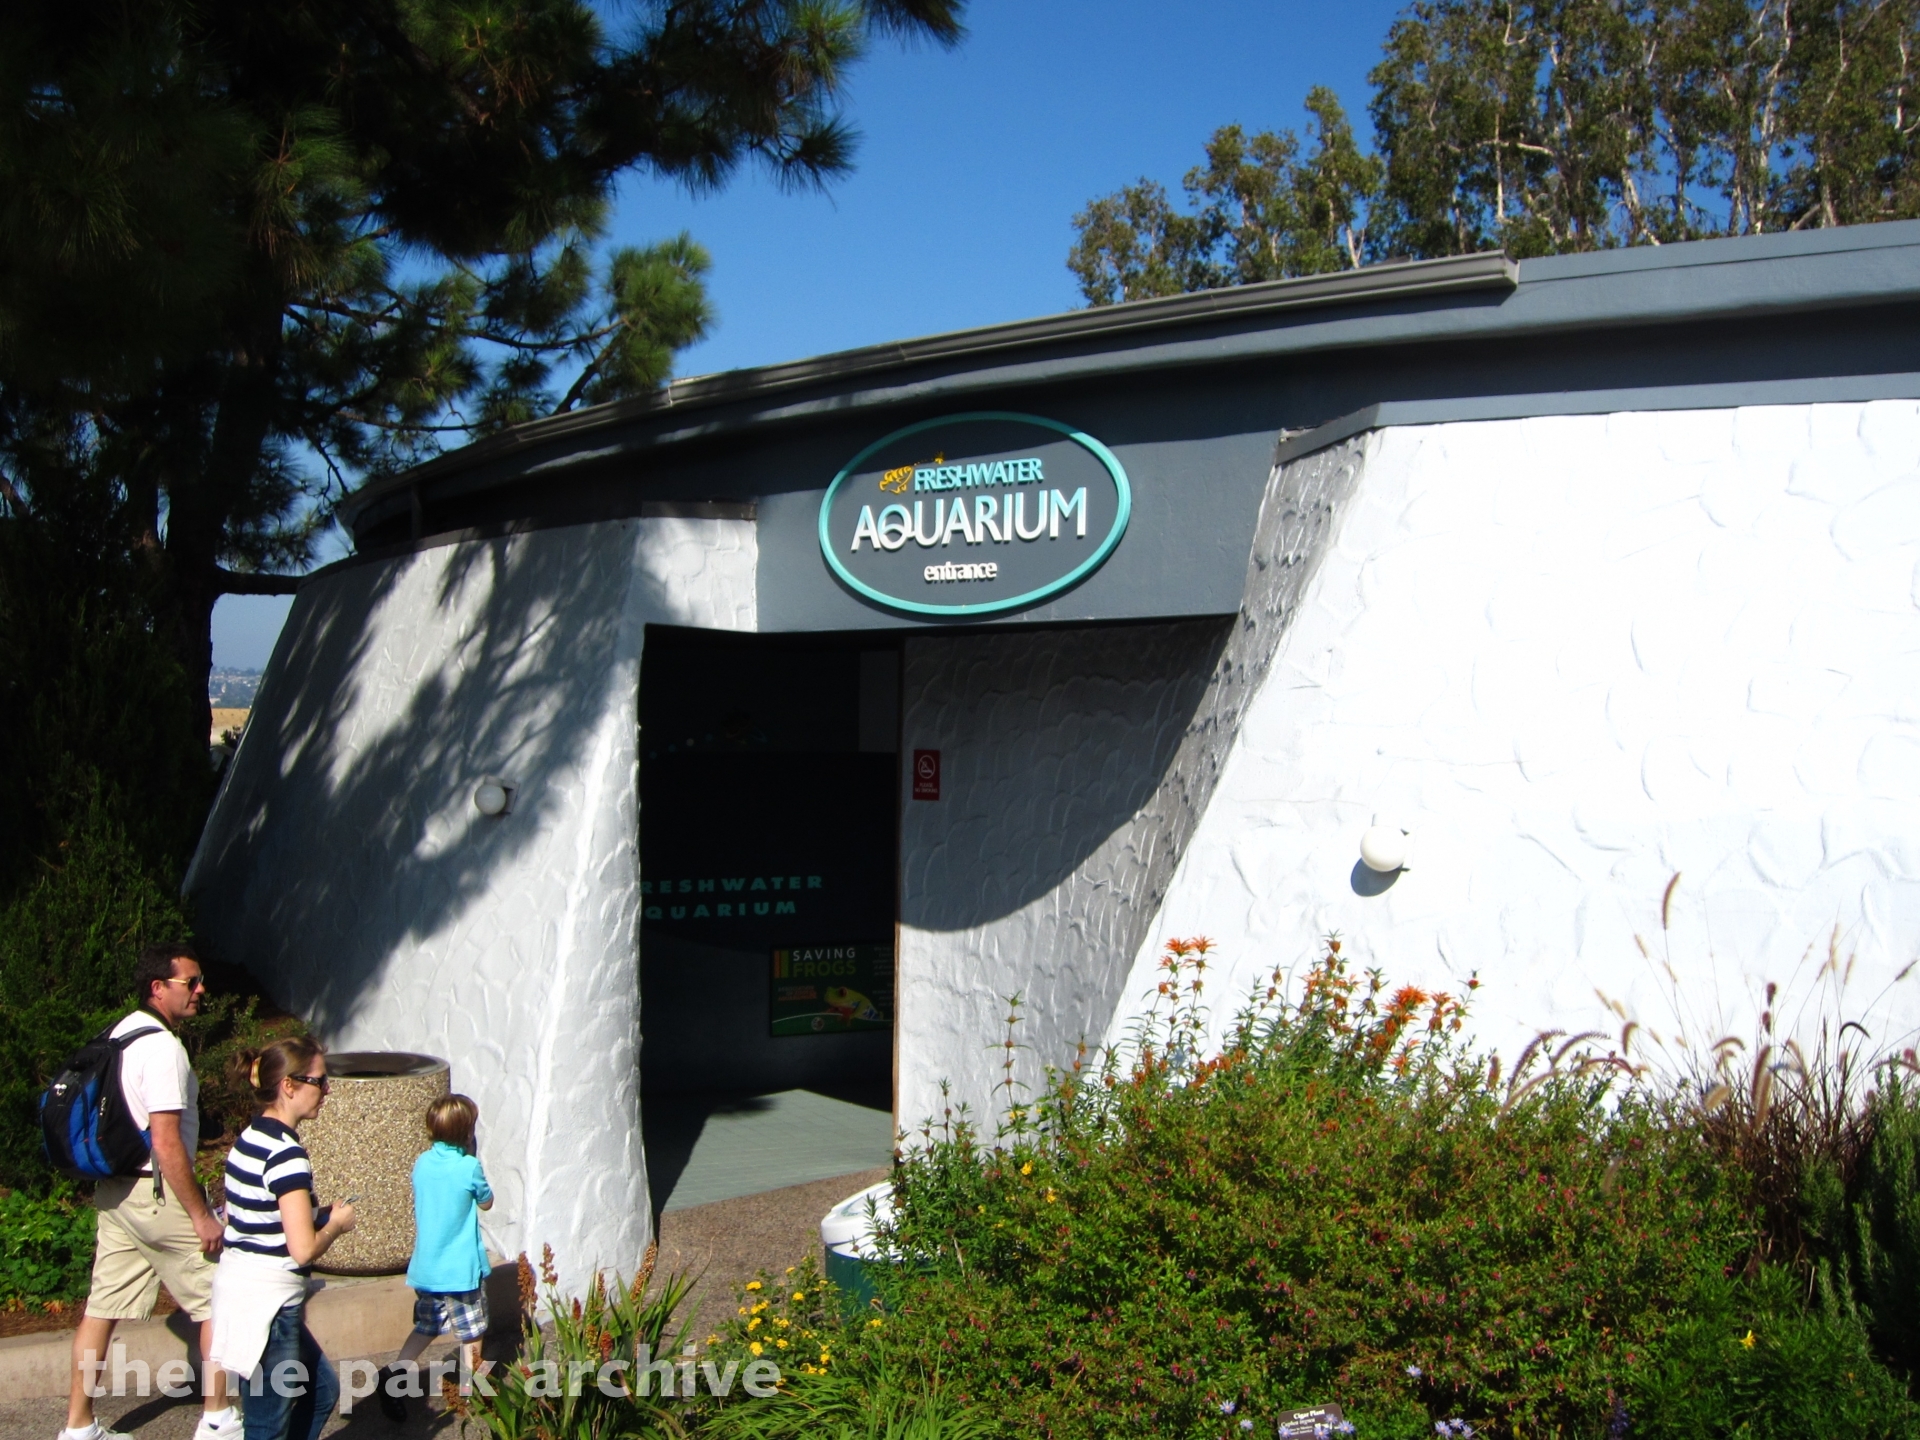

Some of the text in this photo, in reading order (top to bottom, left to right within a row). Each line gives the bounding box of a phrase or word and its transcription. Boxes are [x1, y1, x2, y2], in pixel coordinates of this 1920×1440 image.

[914, 457, 1044, 492] FRESHWATER
[851, 487, 1087, 550] AQUARIUM
[923, 561, 998, 583] entrance
[640, 875, 823, 895] RESHWATER
[645, 900, 796, 920] QUARIUM
[793, 947, 856, 961] SAVING
[793, 960, 857, 978] FROGS
